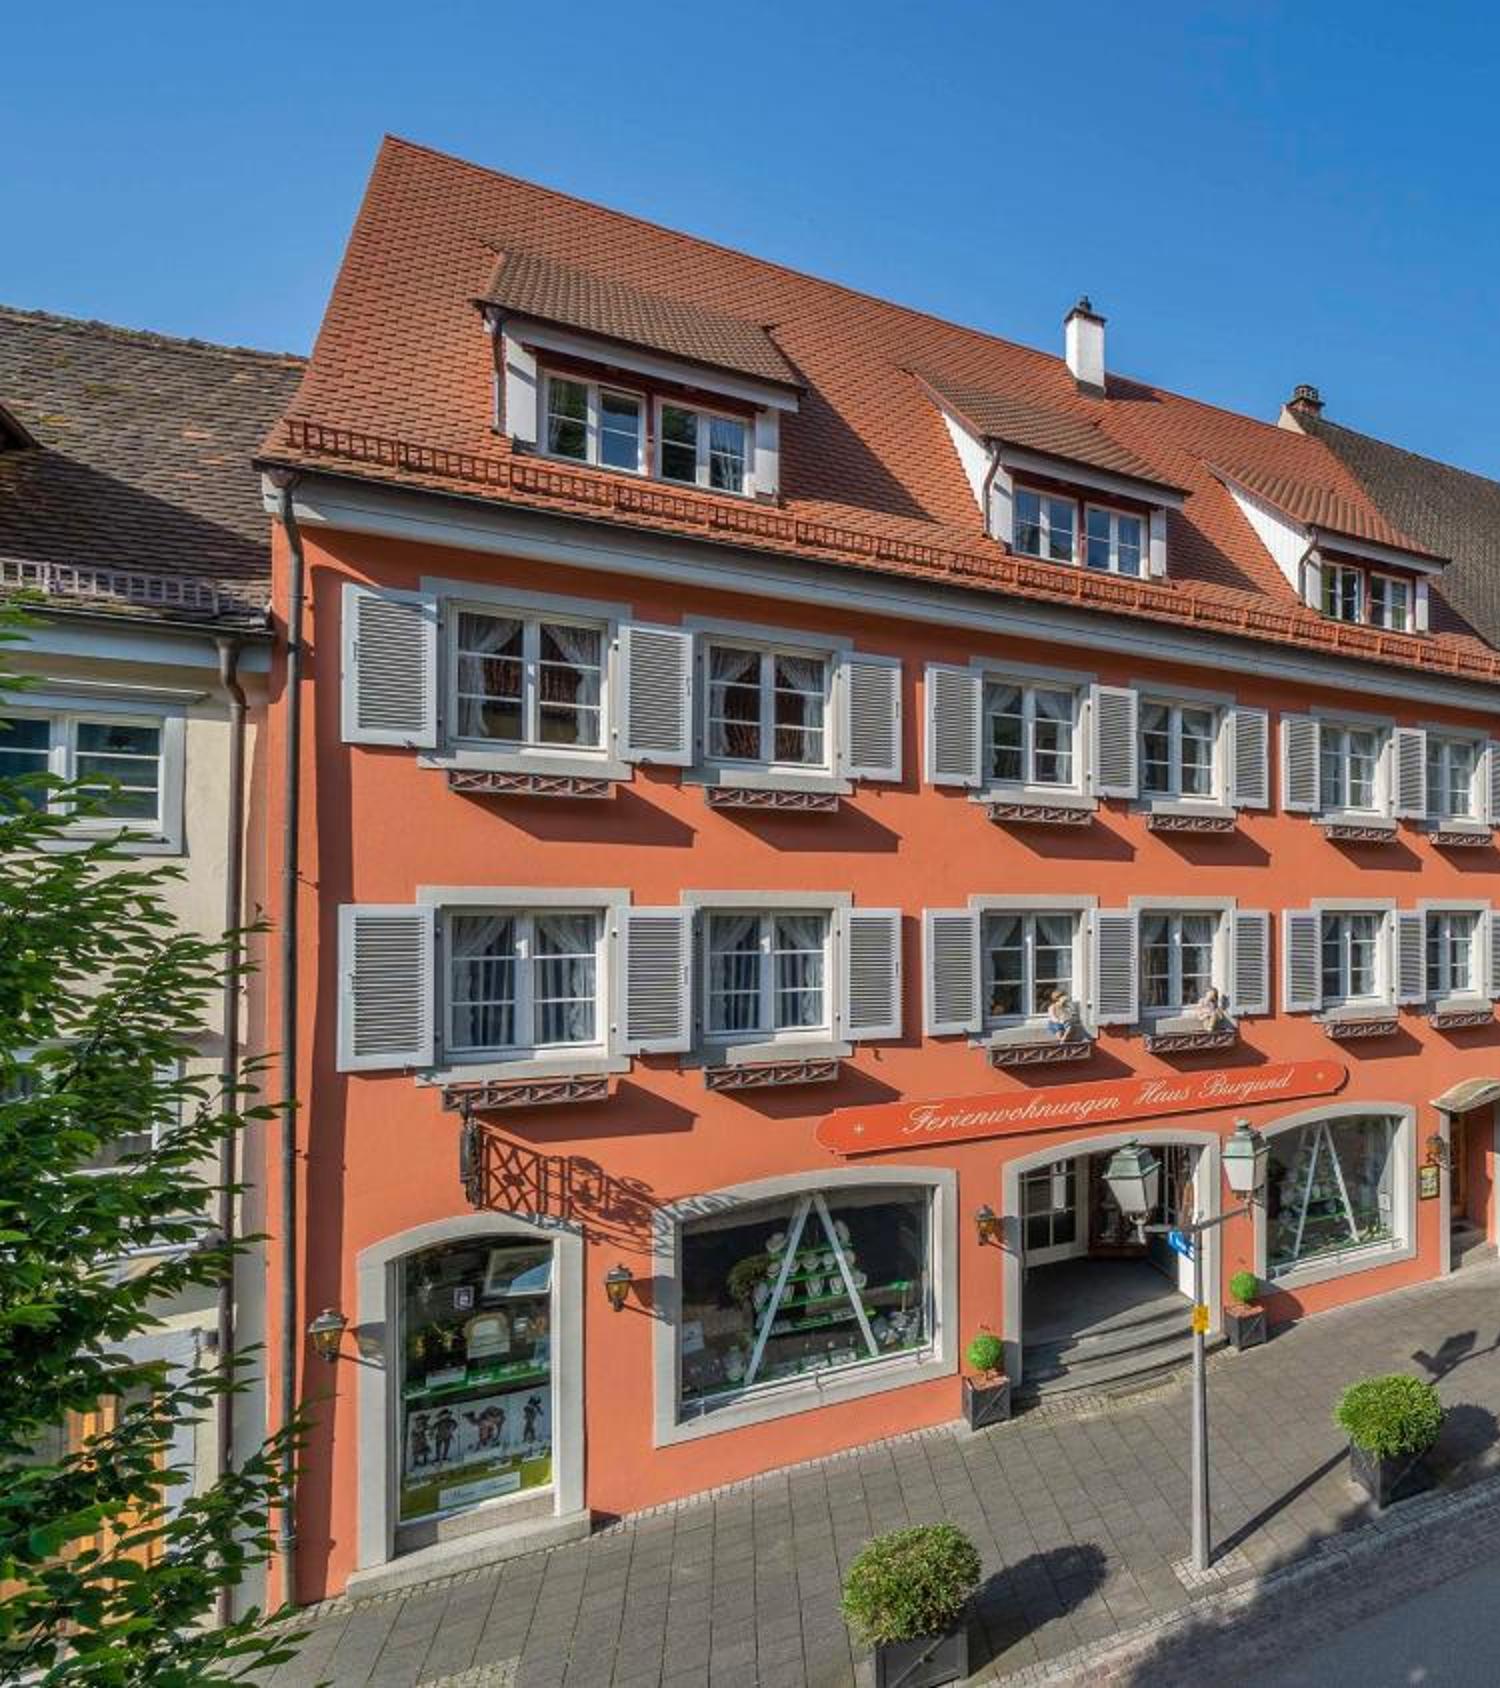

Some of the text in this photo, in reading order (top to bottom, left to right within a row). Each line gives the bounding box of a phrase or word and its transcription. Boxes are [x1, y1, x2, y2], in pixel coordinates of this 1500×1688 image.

[904, 1066, 1296, 1135] Ferienwohnungen Haus Burgund
